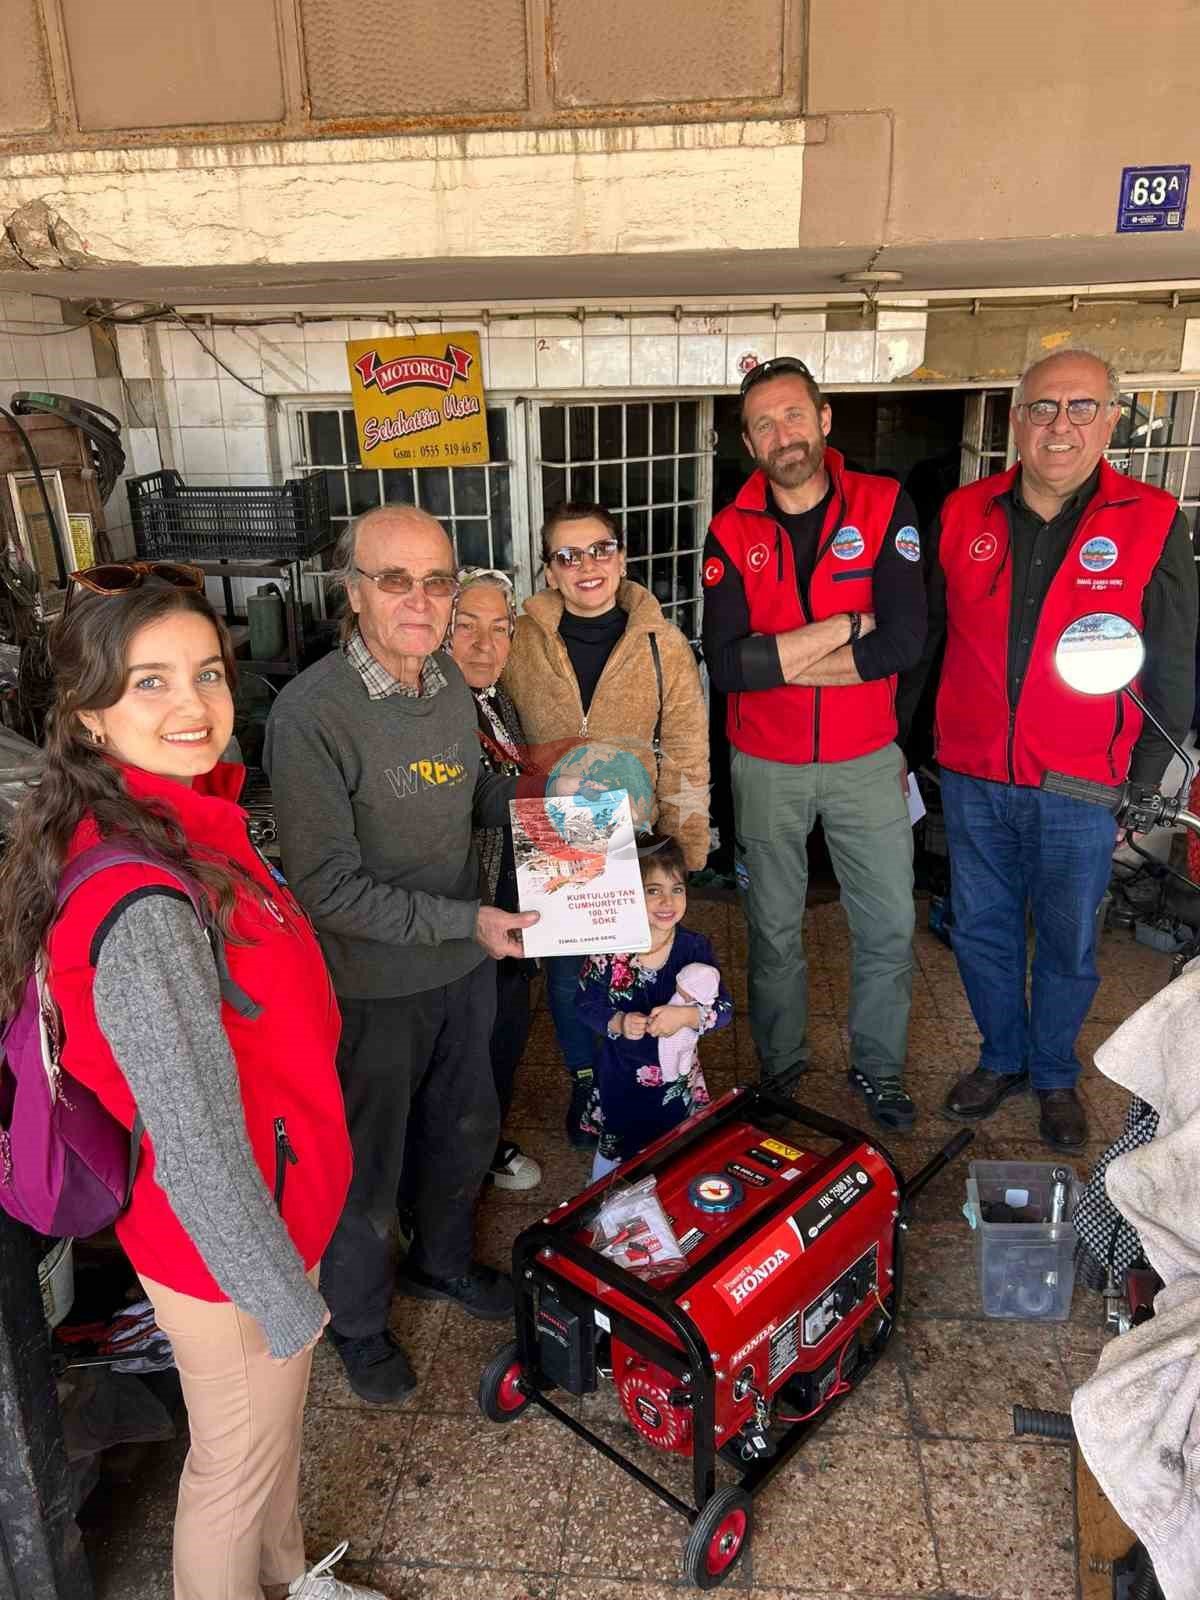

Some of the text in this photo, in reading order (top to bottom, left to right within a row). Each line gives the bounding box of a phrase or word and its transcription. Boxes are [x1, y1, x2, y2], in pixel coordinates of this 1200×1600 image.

[1132, 176, 1167, 206] 63
[380, 361, 450, 386] MOTORCU
[363, 394, 480, 450] Selahattin Usta
[729, 1248, 791, 1305] HONDA
[731, 1321, 776, 1366] HONDA
